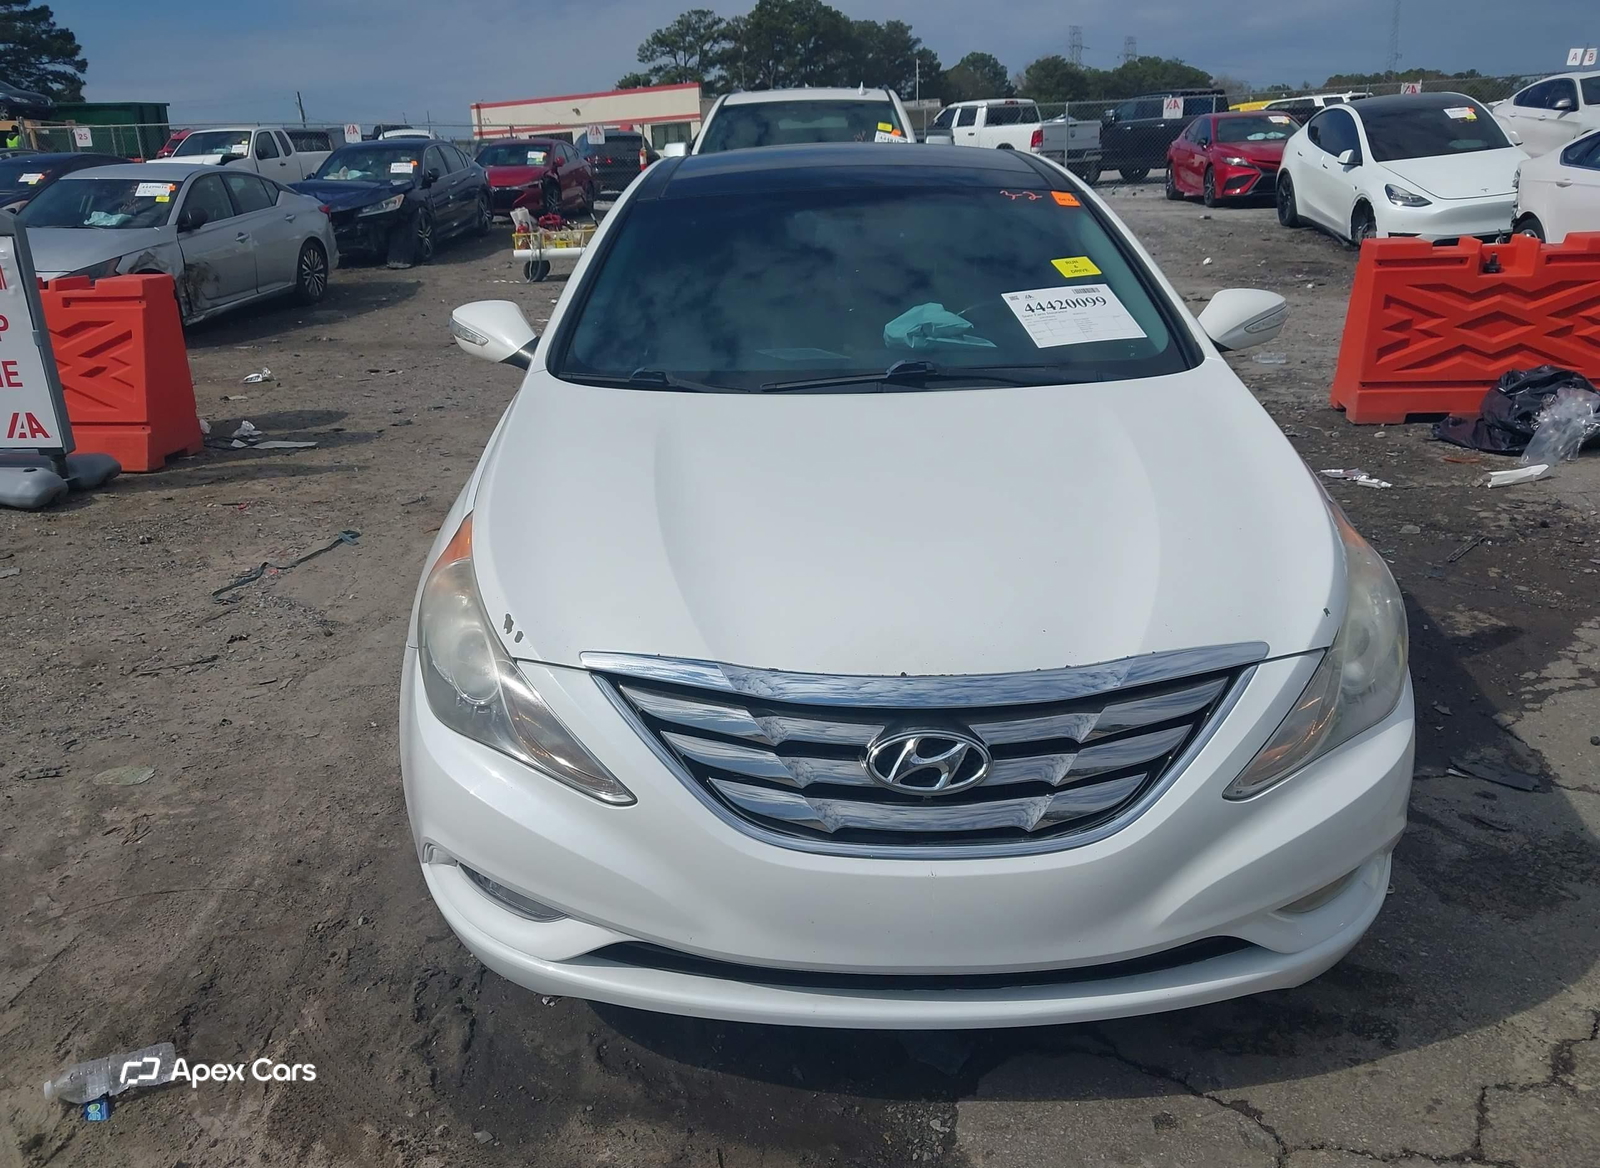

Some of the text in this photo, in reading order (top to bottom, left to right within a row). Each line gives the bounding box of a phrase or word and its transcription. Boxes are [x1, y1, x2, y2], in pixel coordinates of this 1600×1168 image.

[1571, 52, 1577, 61] A
[1588, 52, 1594, 61] B
[1024, 295, 1107, 314] 44420099
